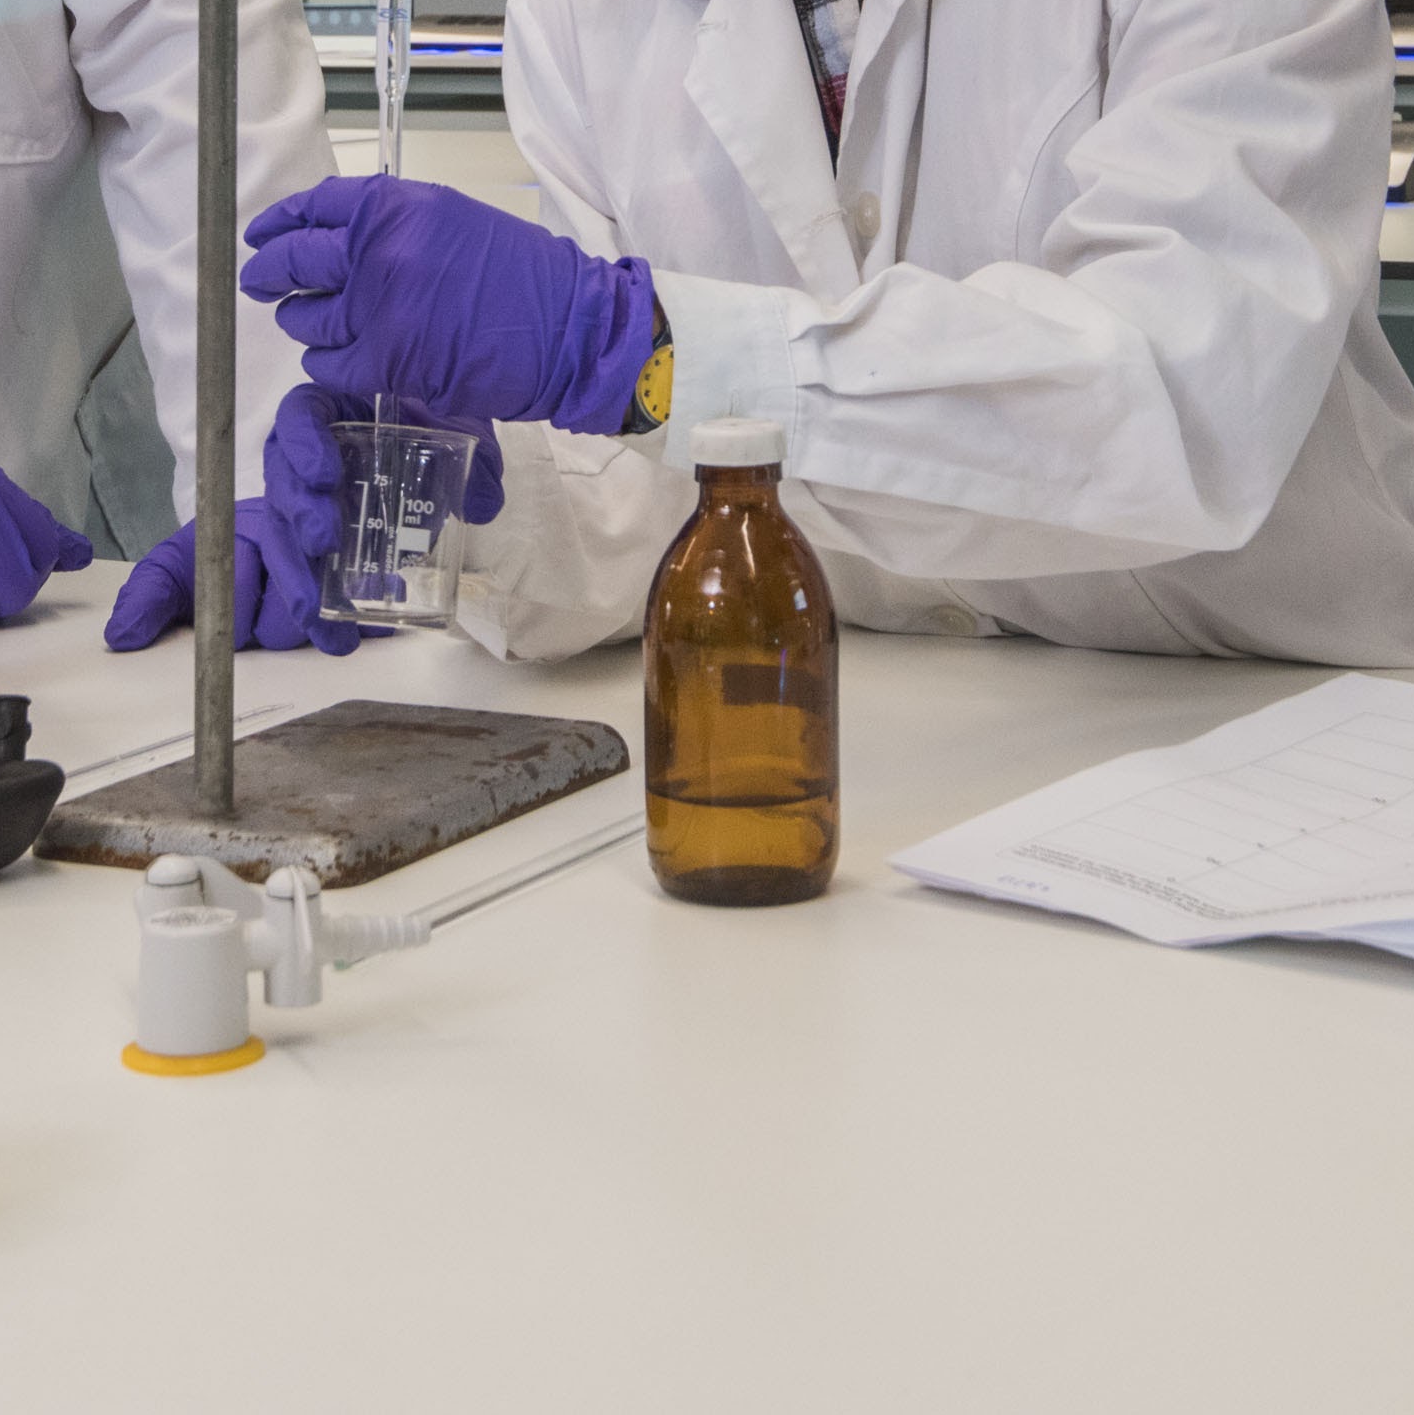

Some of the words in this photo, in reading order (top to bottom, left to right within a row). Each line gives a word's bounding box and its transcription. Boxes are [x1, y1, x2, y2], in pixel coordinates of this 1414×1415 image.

[373, 473, 388, 486] 75
[405, 499, 435, 515] 100
[366, 517, 383, 530] 50
[404, 514, 422, 525] ml
[362, 561, 379, 573] 25
